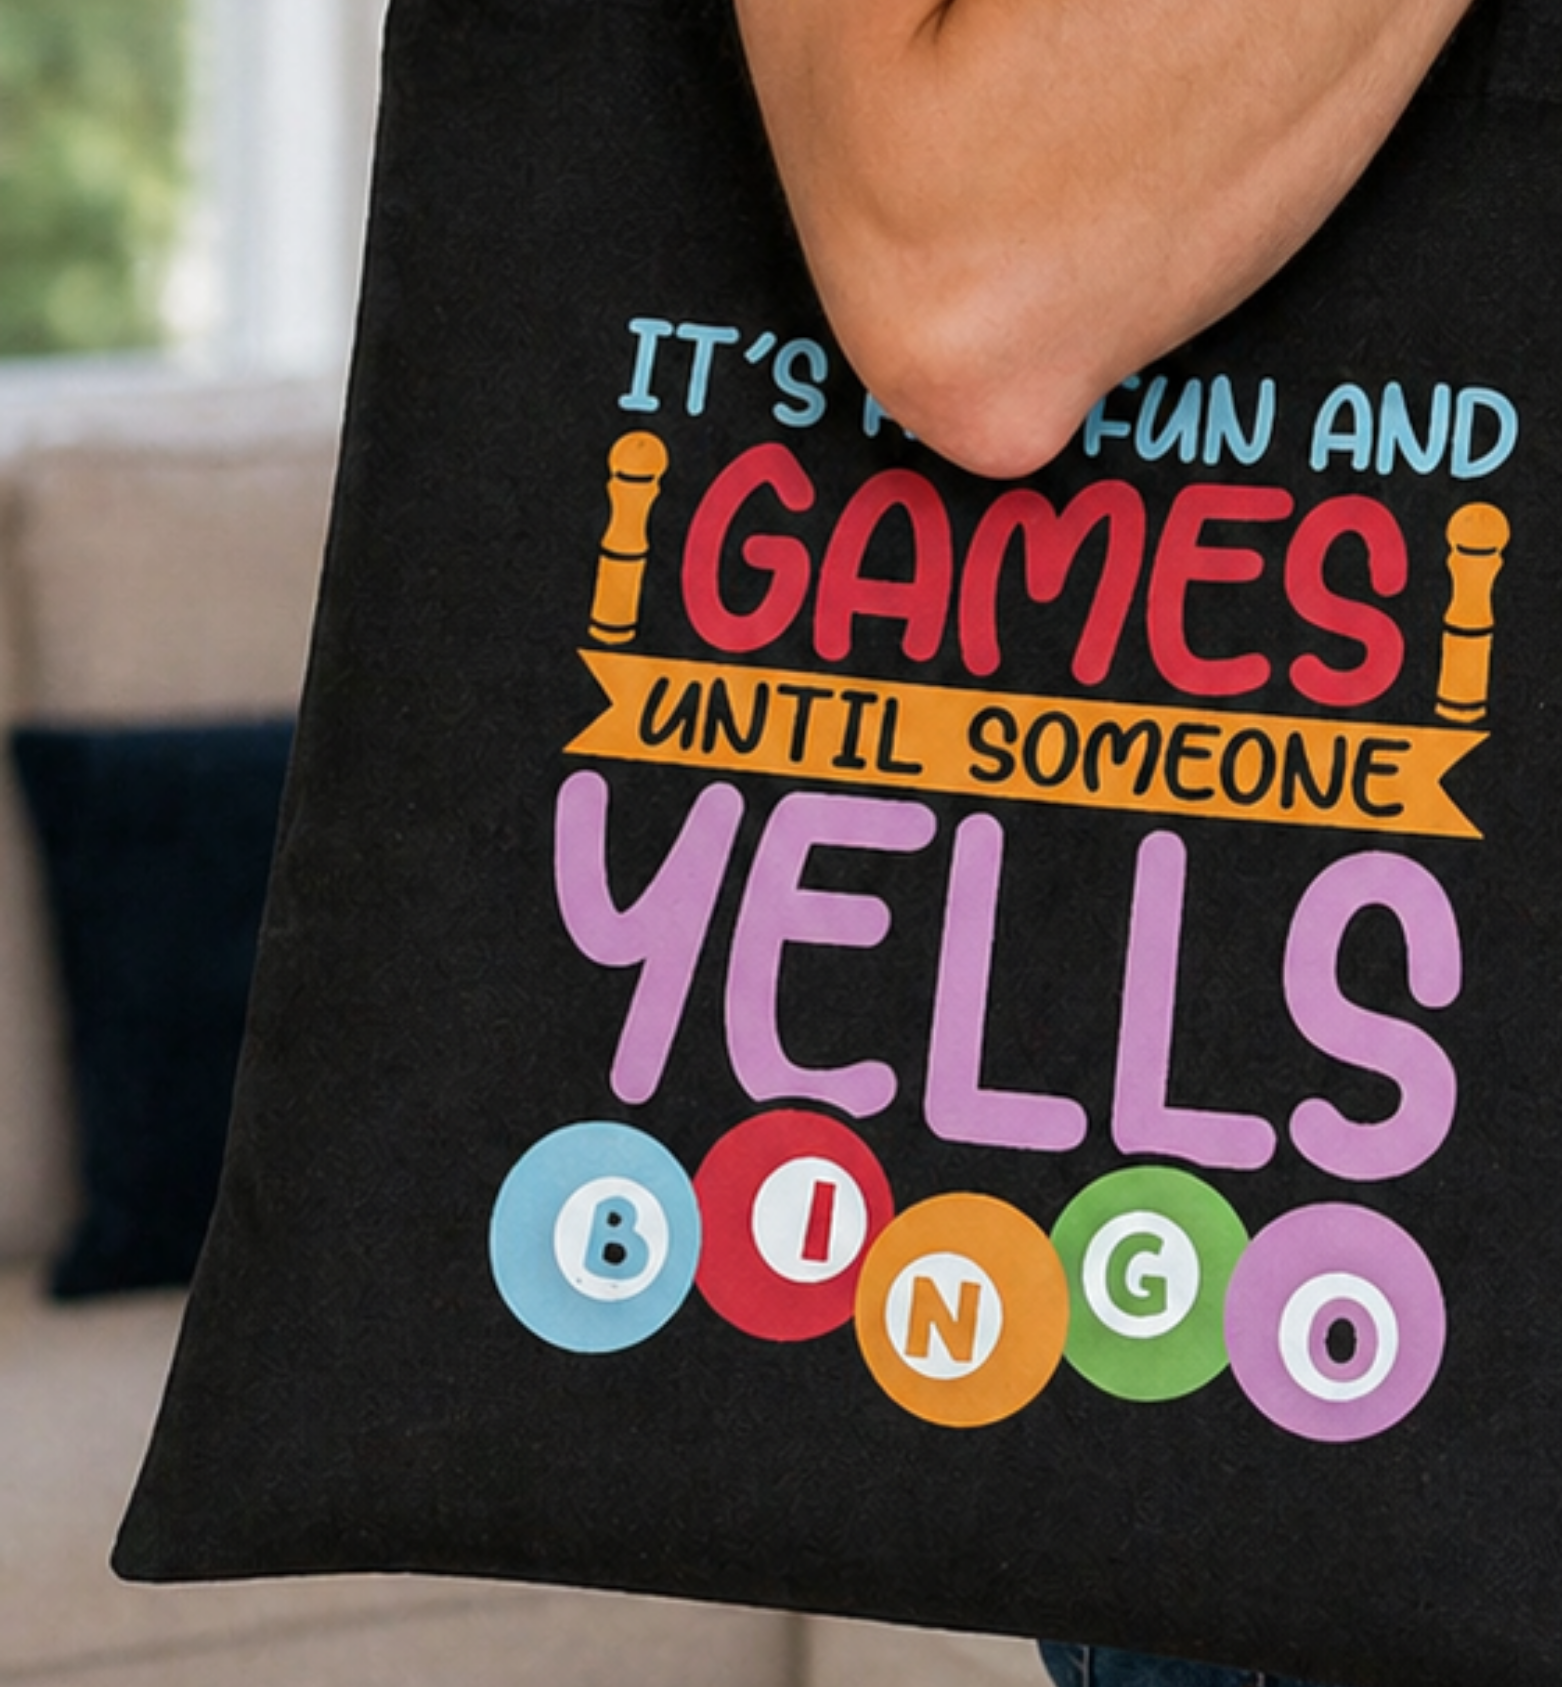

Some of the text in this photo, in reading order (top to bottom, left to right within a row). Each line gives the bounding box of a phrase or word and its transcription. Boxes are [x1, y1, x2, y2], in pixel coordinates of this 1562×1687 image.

[618, 317, 829, 428] IT’S
[1083, 373, 1277, 466] FUN
[1310, 381, 1519, 480] AND
[681, 442, 1408, 707] GAMES
[638, 676, 1412, 817] UNTIL SOMEONE
[554, 769, 1463, 1181] YELLS
